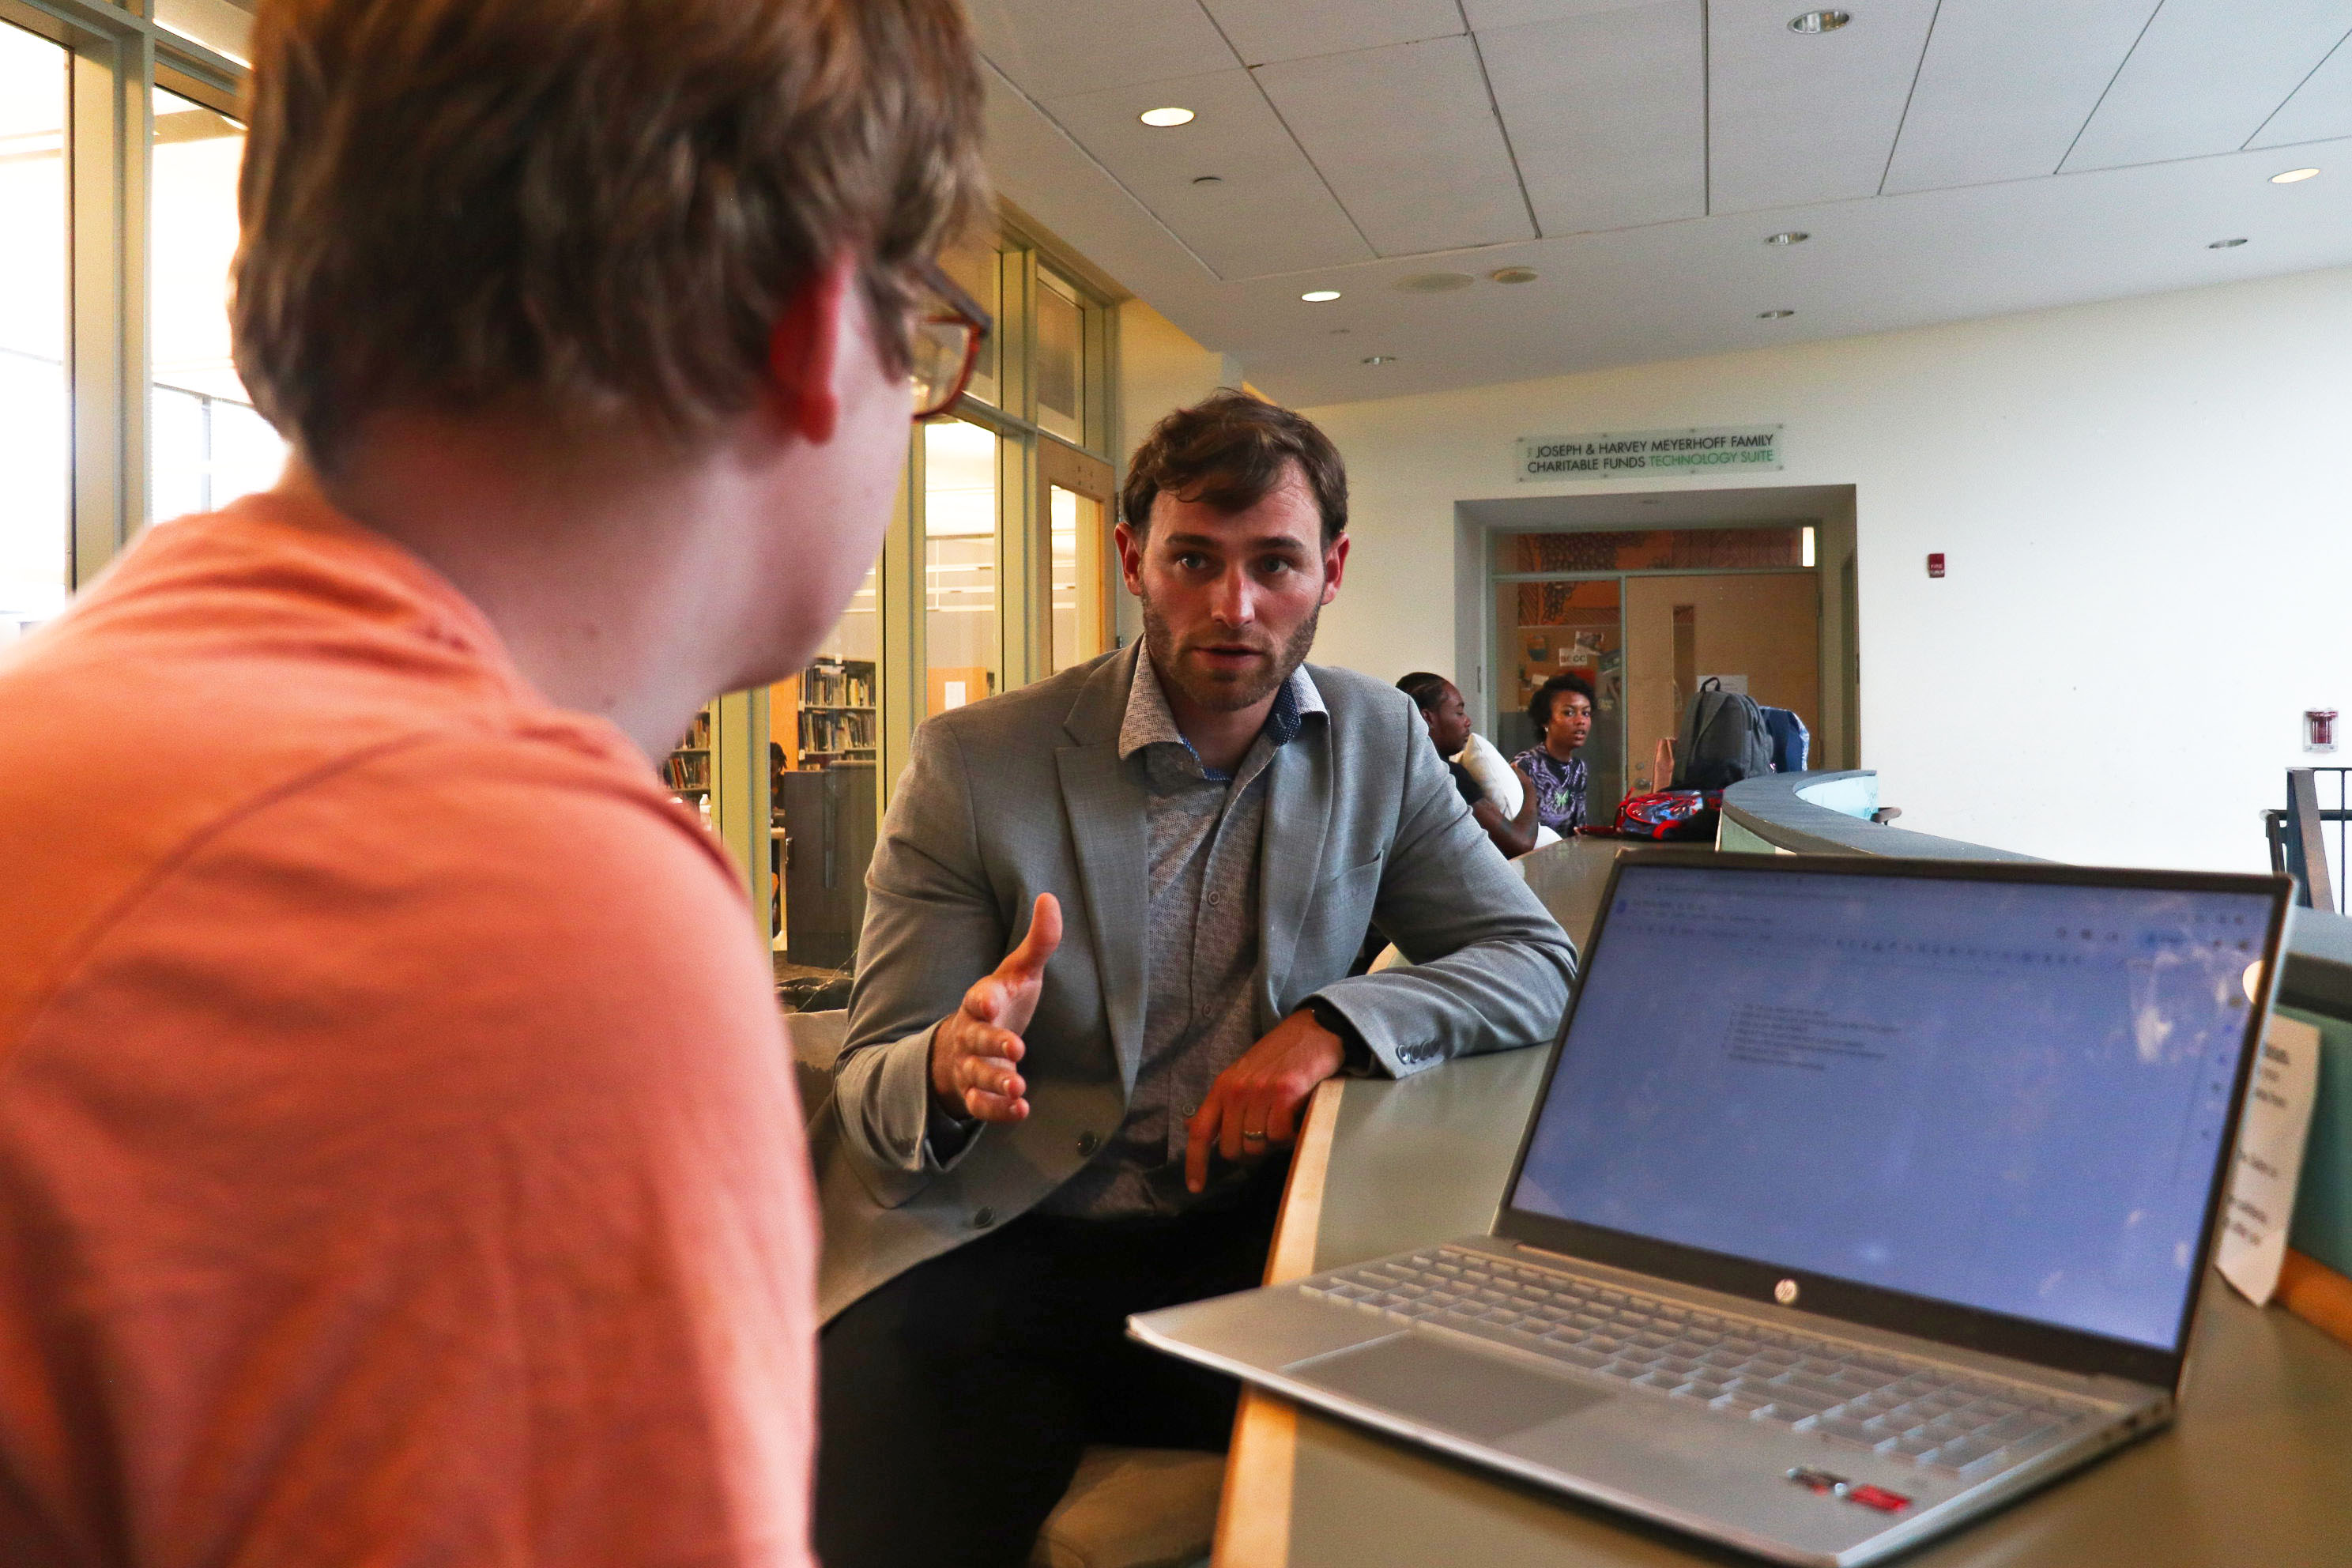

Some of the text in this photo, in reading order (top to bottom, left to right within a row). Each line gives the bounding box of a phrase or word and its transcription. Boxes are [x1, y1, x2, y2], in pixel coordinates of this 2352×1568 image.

[1536, 444, 1581, 458] JOSEPH
[1585, 443, 1595, 455] &
[1599, 441, 1647, 454] HARVEY
[1650, 436, 1727, 452] MEYERHOFF
[1731, 433, 1773, 447] FAMILY
[1527, 450, 1773, 473] CHARITABLE FUNDS TECHNOLOGY SUITE
